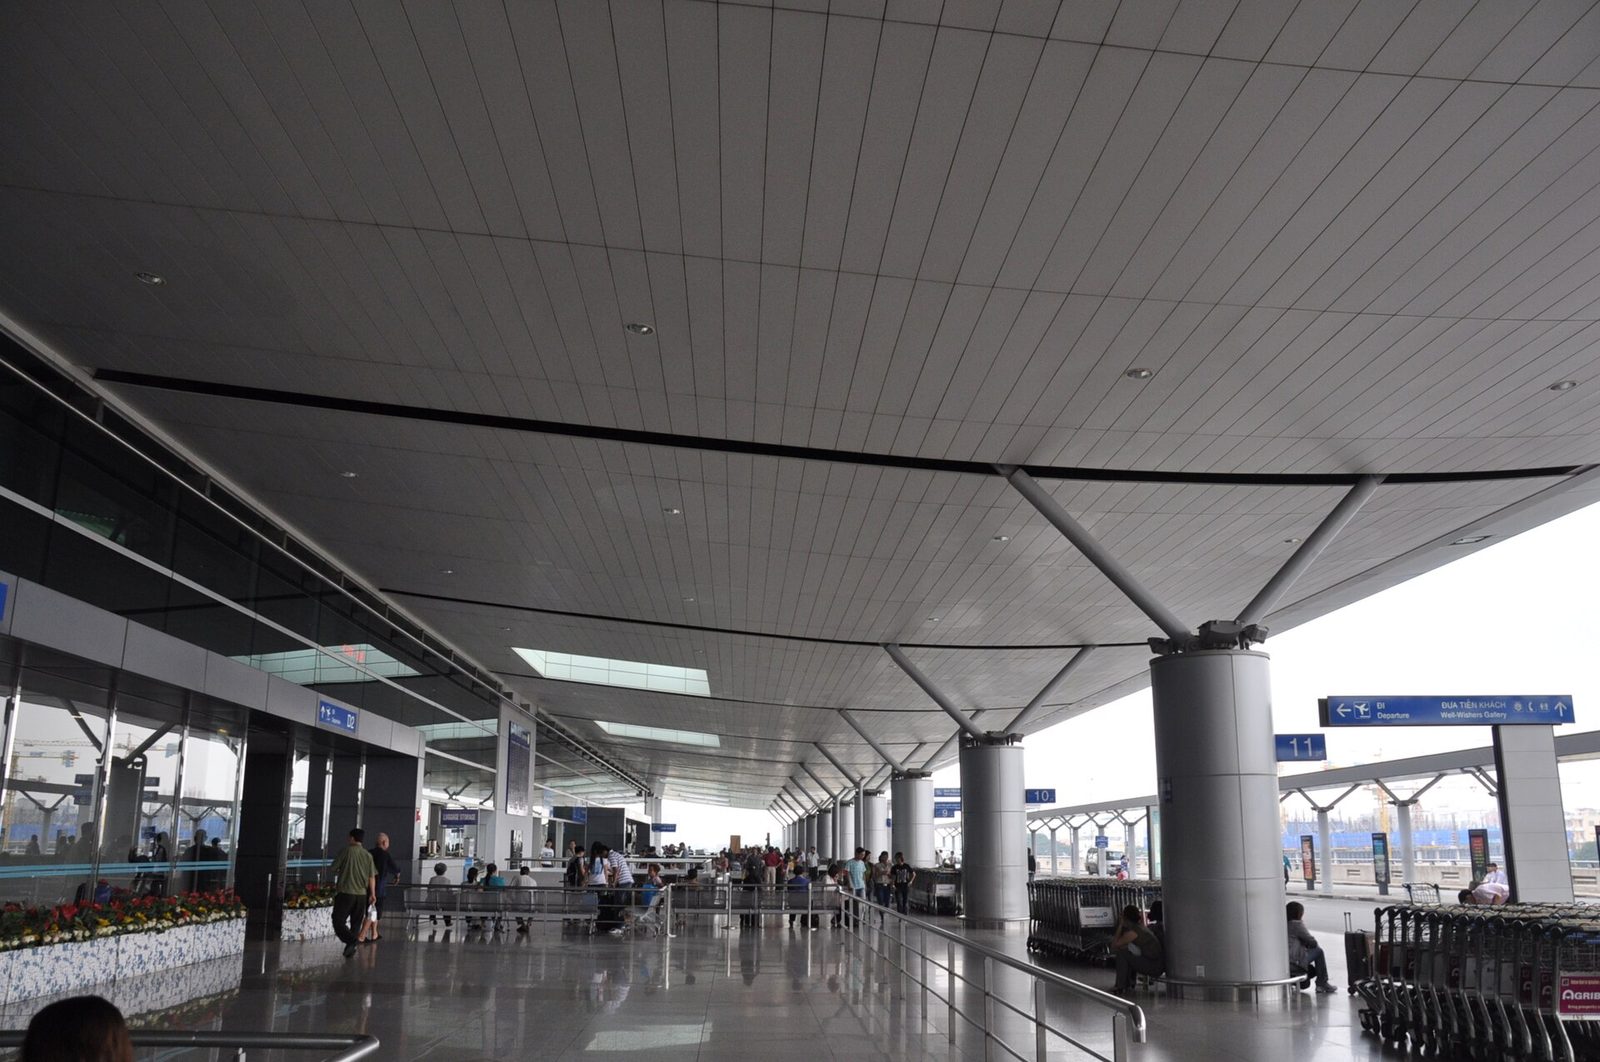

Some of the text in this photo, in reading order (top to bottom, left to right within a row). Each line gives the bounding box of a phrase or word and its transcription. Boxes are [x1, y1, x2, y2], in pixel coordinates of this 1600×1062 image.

[1376, 702, 1385, 710] ĐI
[1479, 699, 1506, 709] KHÁCH
[1377, 712, 1410, 720] Departure
[1440, 711, 1507, 720] Well-Wishers Gallery
[346, 713, 355, 729] D2
[1289, 737, 1312, 757] 11
[1034, 790, 1050, 802] 10
[942, 809, 948, 817] 9
